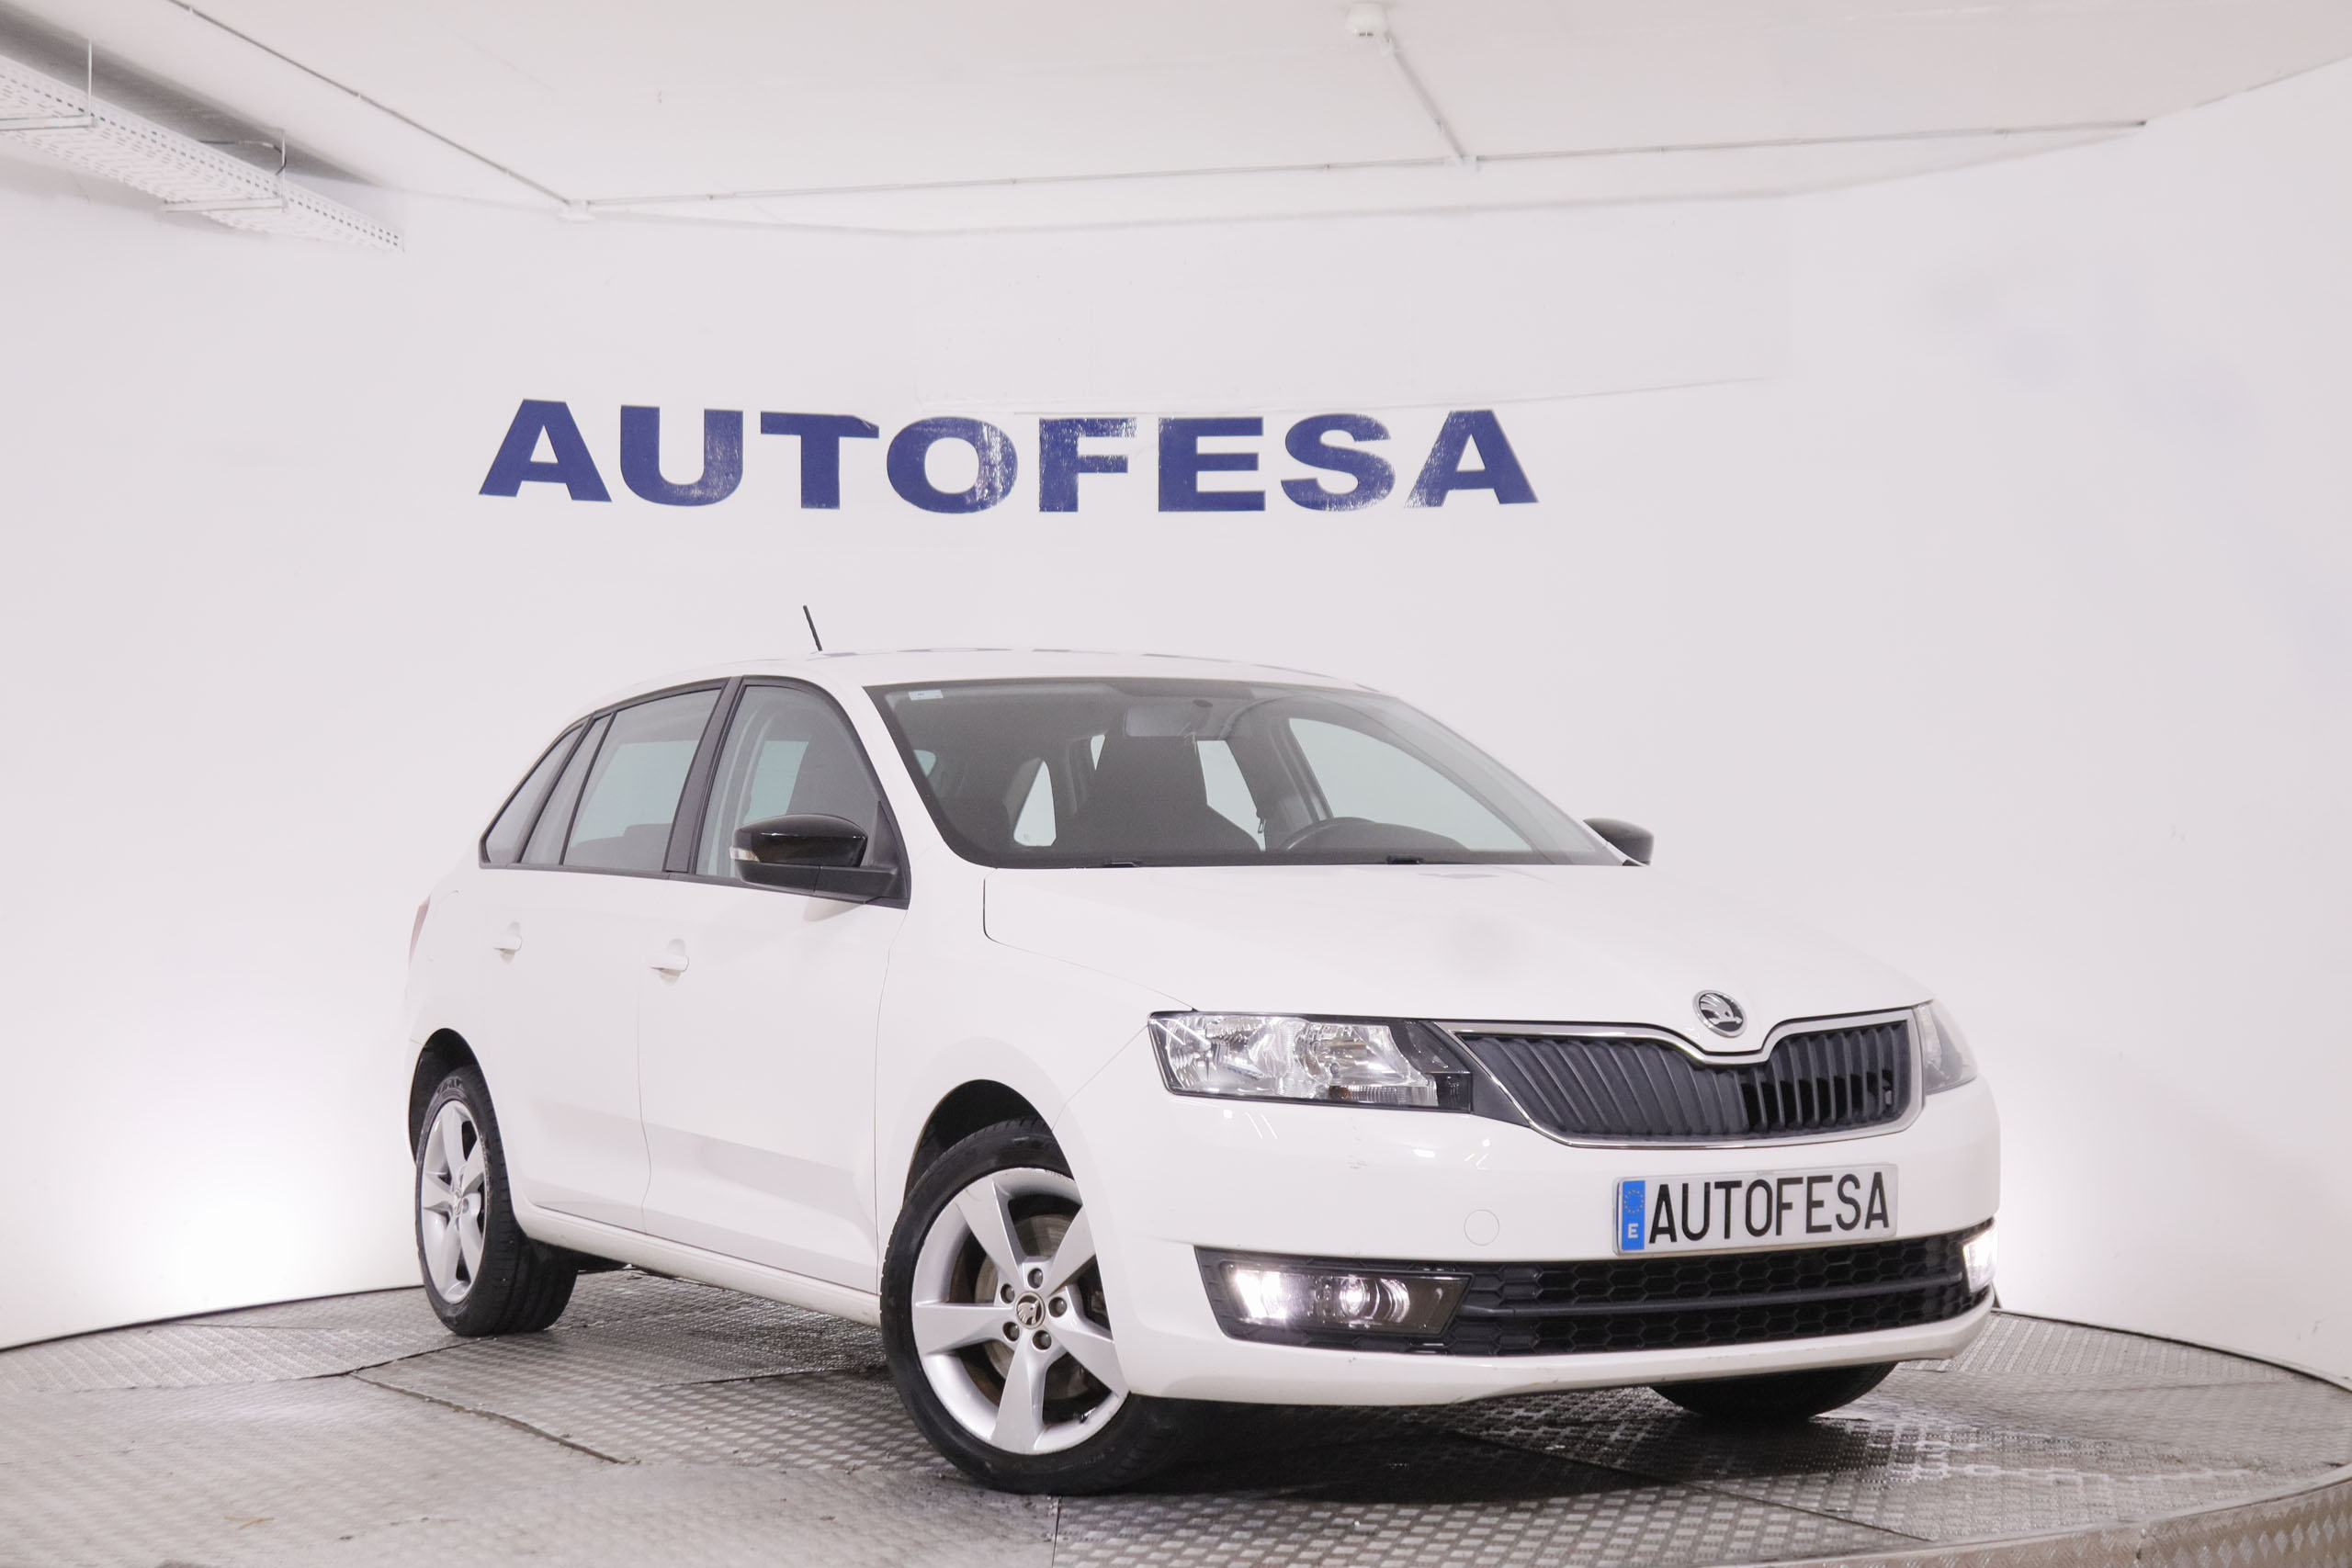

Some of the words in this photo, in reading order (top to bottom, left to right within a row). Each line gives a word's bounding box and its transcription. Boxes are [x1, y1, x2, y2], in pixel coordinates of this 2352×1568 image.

[479, 398, 1538, 513] AUTOFESA
[1627, 1223, 1639, 1238] E
[1649, 1171, 1889, 1244] AUTOFESA
